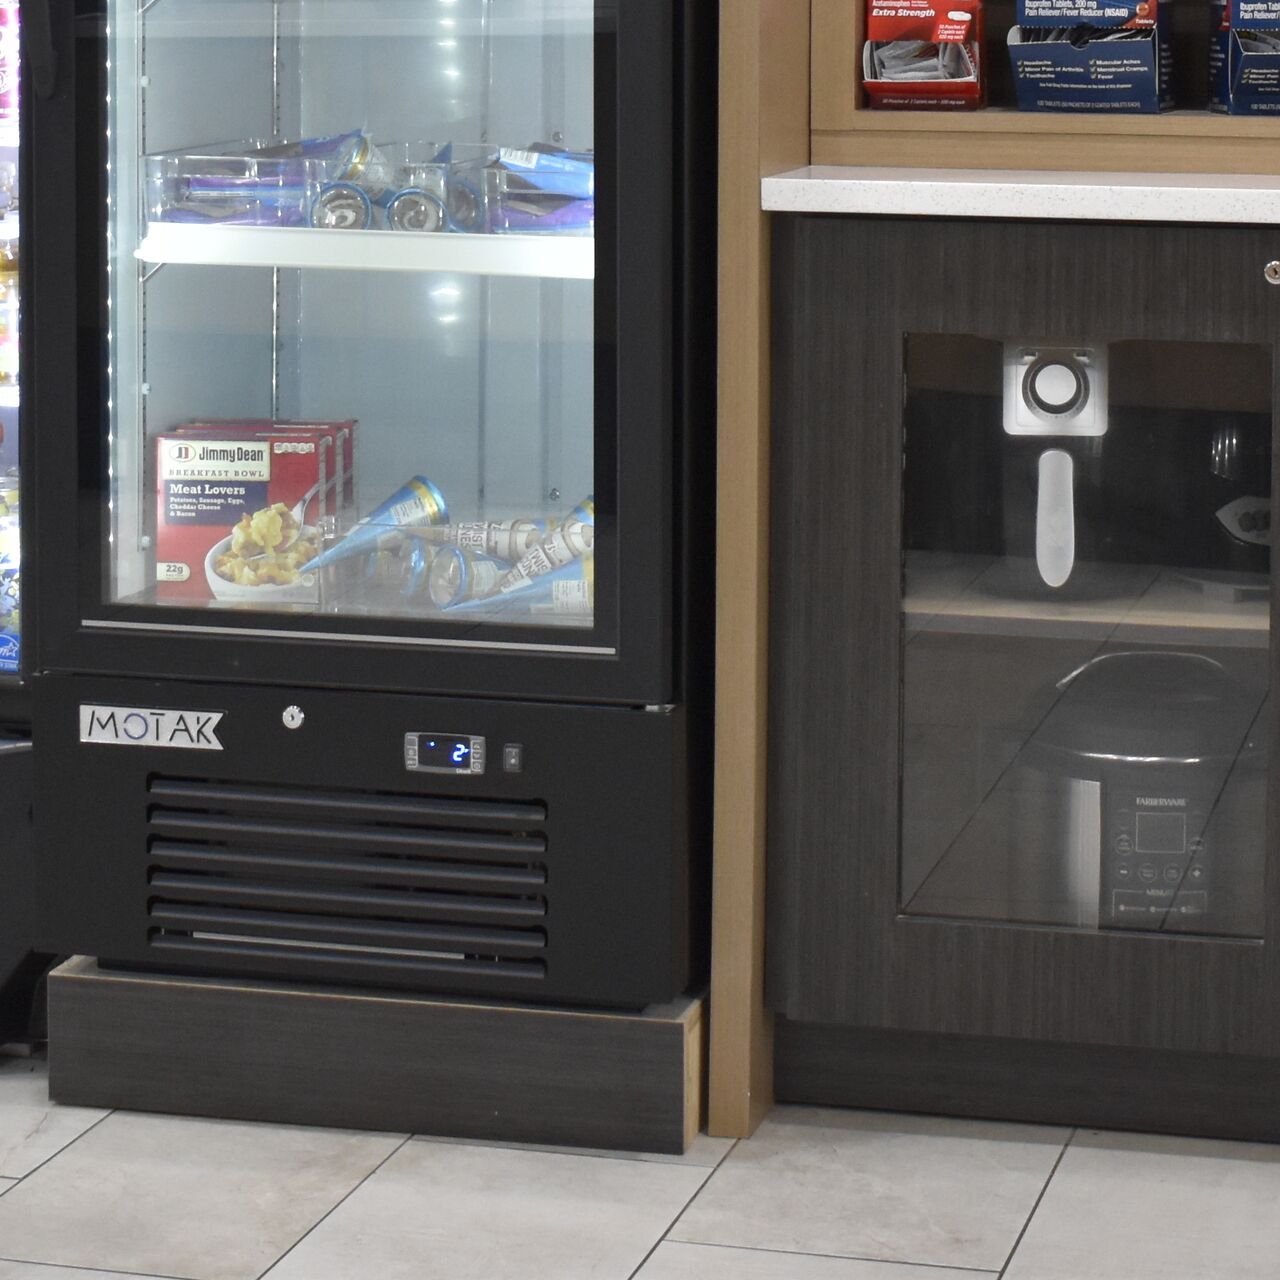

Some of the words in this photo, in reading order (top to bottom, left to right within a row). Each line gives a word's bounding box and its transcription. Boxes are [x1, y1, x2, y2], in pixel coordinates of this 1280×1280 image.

[1025, 0, 1052, 8] Ibuprofen
[1075, 0, 1086, 7] 200
[1087, 0, 1097, 9] mg
[1240, 2, 1267, 11] Ibuprofen
[872, 9, 896, 17] Extra
[897, 9, 935, 17] Strength
[1025, 8, 1038, 17] Pain
[1079, 8, 1104, 17] Reducer
[1104, 8, 1128, 18] (NSAID)
[1240, 11, 1252, 19] Pain
[169, 469, 231, 478] BREAKFAST
[234, 469, 265, 478] BOWL
[169, 484, 196, 495] Meat
[198, 484, 246, 495] Lovers
[166, 564, 185, 575] 22g
[88, 710, 212, 744] MOTAK
